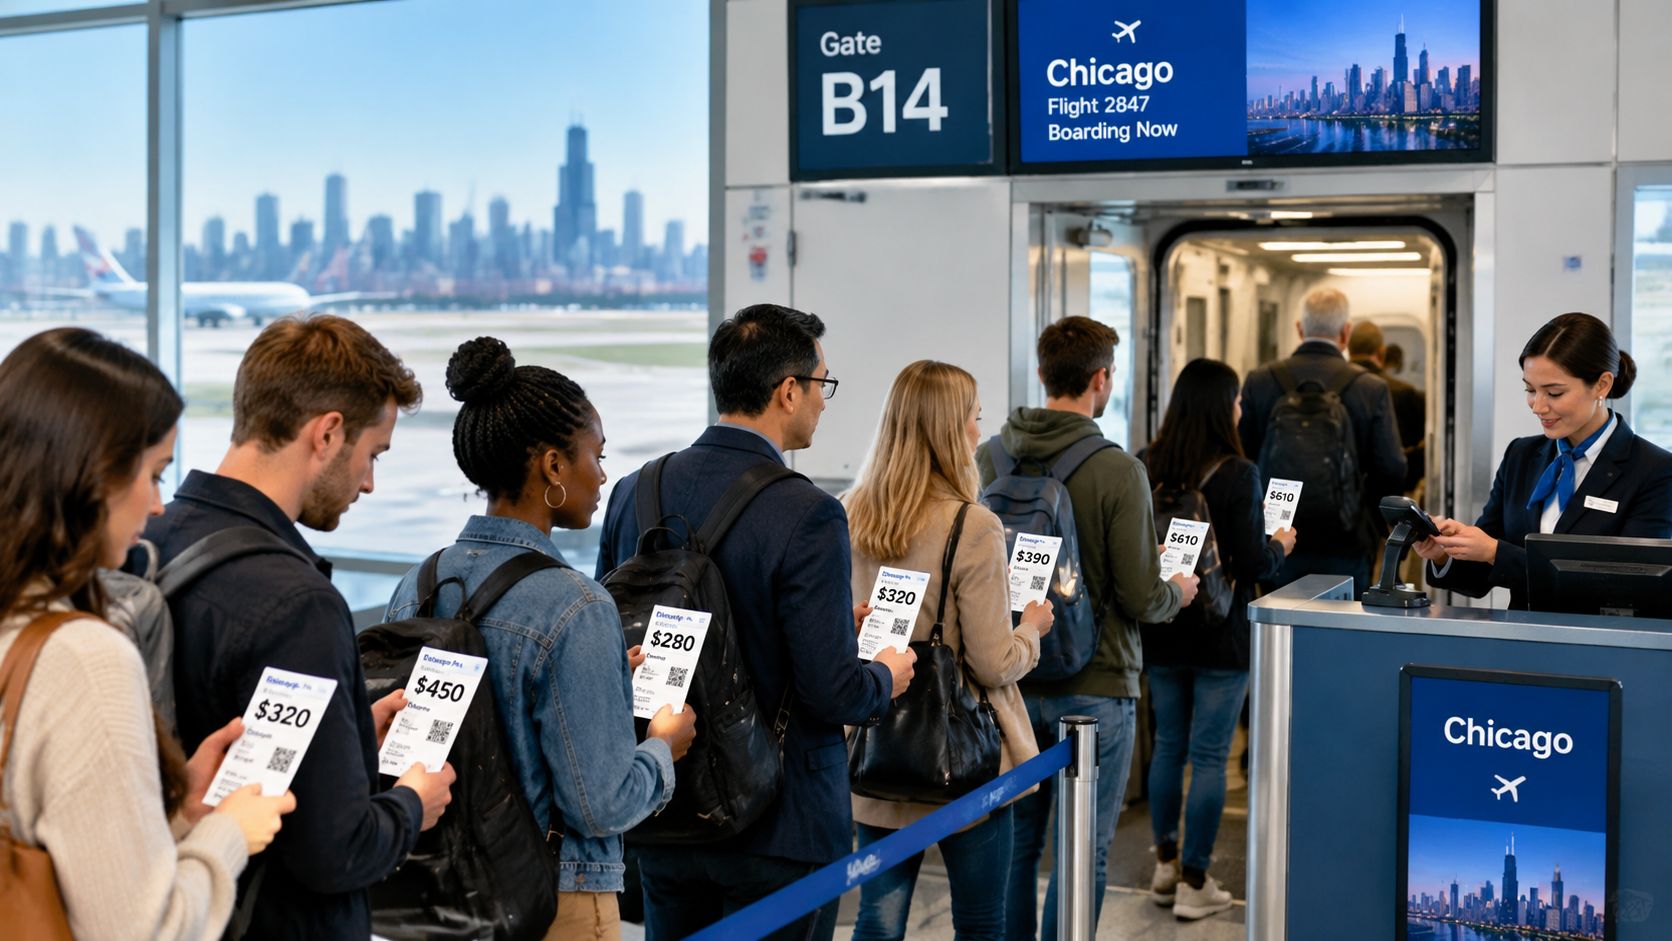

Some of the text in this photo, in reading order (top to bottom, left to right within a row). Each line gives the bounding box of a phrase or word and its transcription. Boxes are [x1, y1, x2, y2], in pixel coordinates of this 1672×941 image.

[820, 31, 882, 57] Gate
[1047, 57, 1174, 90] Chicago
[822, 67, 949, 136] B14
[1048, 95, 1150, 119] Flight 2847
[1048, 121, 1178, 143] Boarding Now
[1270, 490, 1294, 502] $610
[1170, 532, 1199, 546] $610
[1016, 549, 1050, 565] $390
[877, 586, 916, 605] $320
[650, 629, 695, 652] $280
[414, 675, 465, 702] $450
[254, 699, 311, 728] $320
[1443, 716, 1574, 759] Chicago
